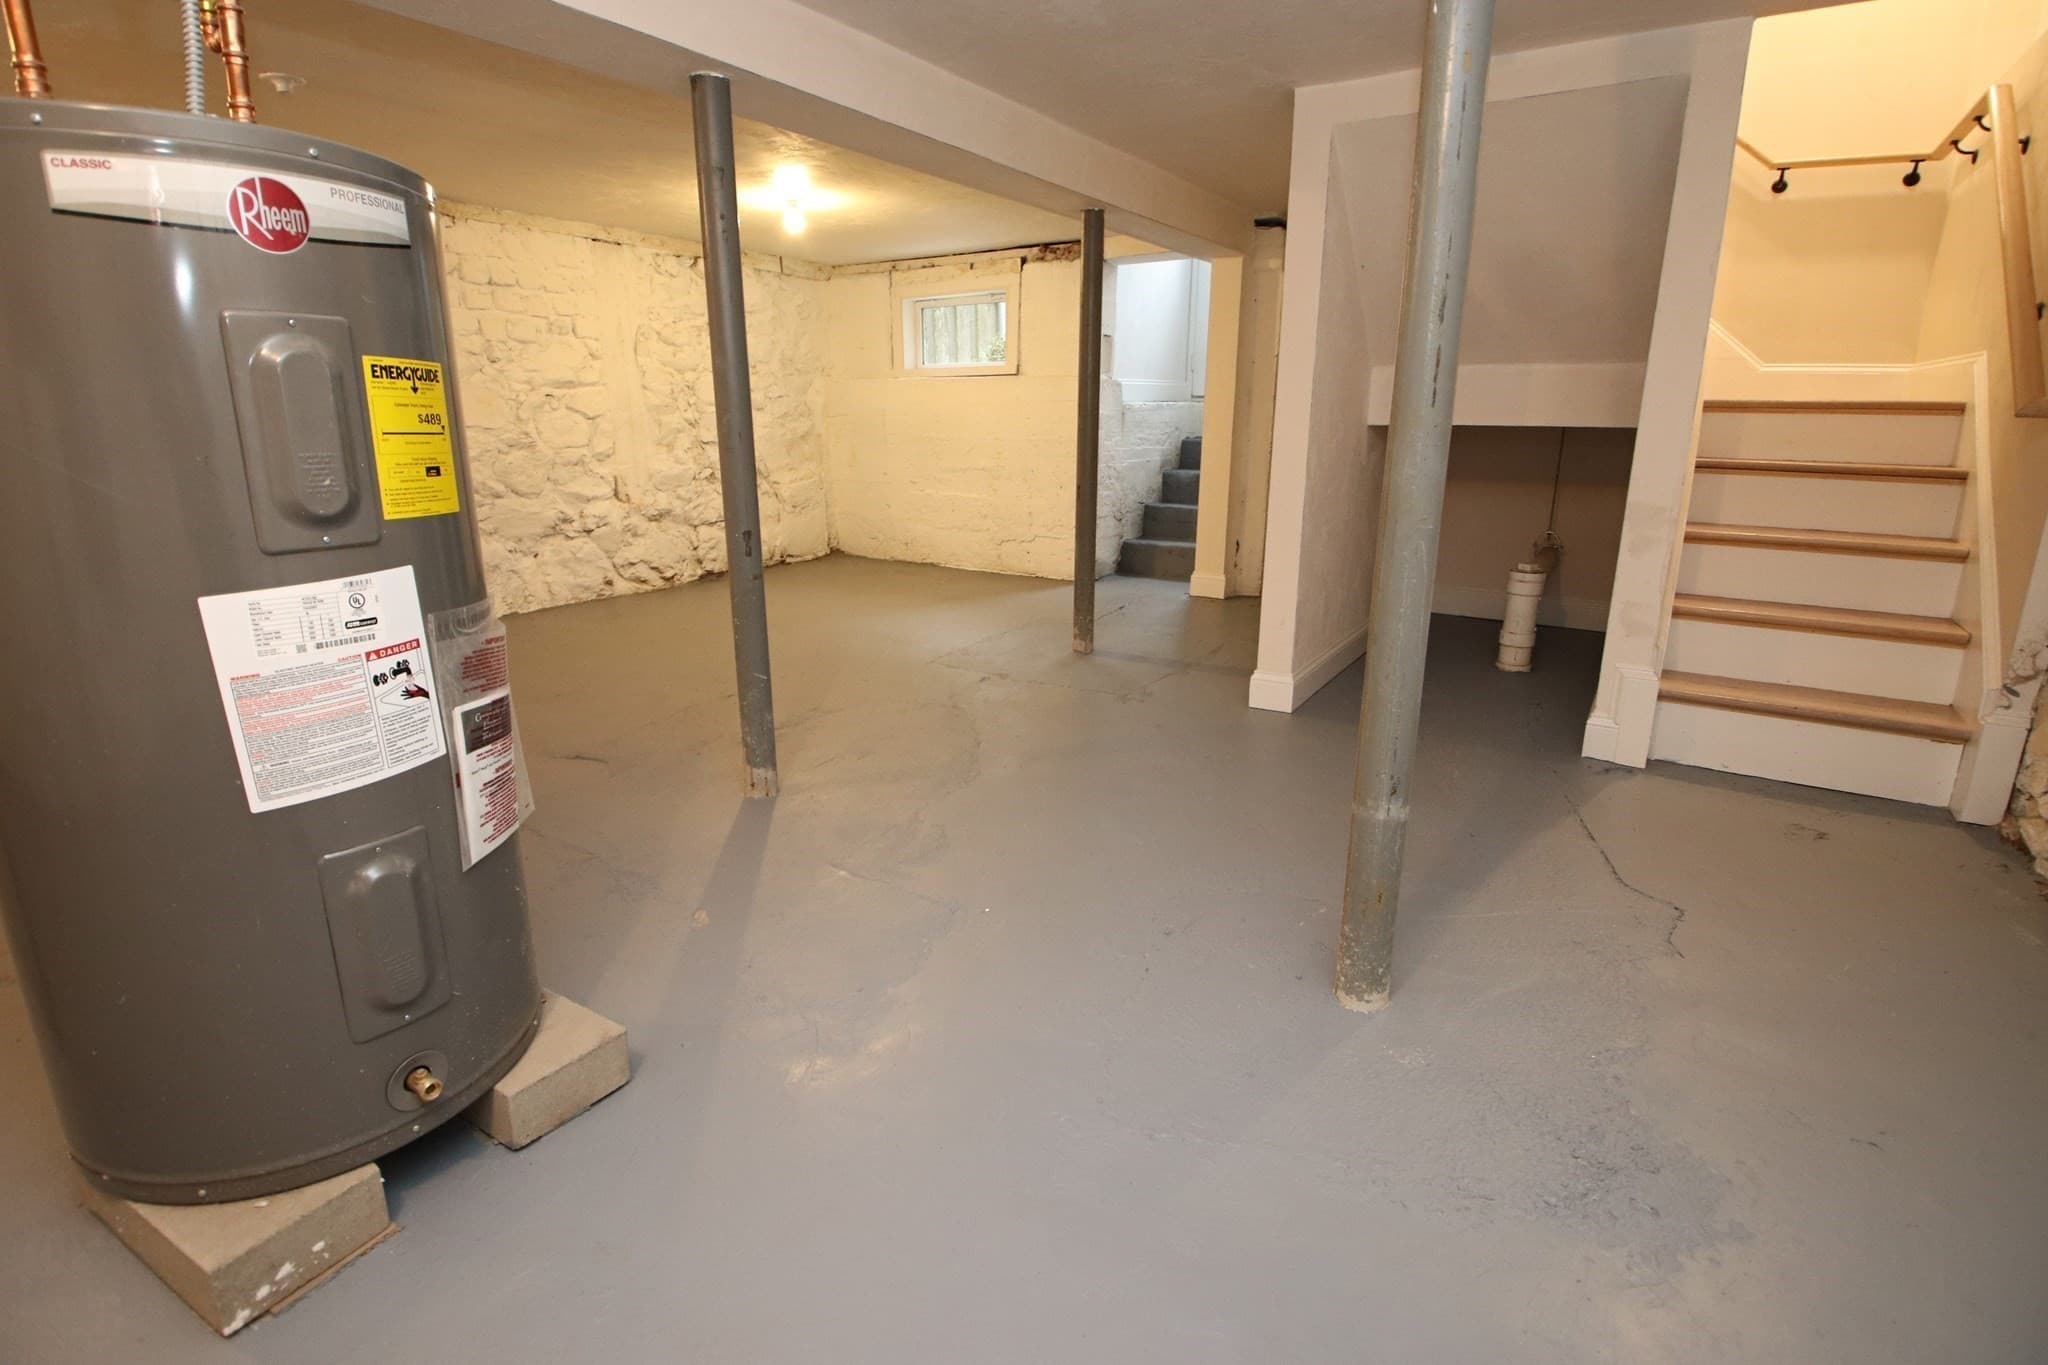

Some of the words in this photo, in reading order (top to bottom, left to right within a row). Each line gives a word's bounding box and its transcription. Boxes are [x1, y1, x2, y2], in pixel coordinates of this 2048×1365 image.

[50, 156, 113, 170] CLASSIC
[235, 177, 307, 241] Rheem
[330, 187, 405, 215] PROFESSIONAL
[370, 364, 440, 384] ENERGYGUIDE
[417, 413, 442, 426] $489
[379, 641, 418, 658] DANGER
